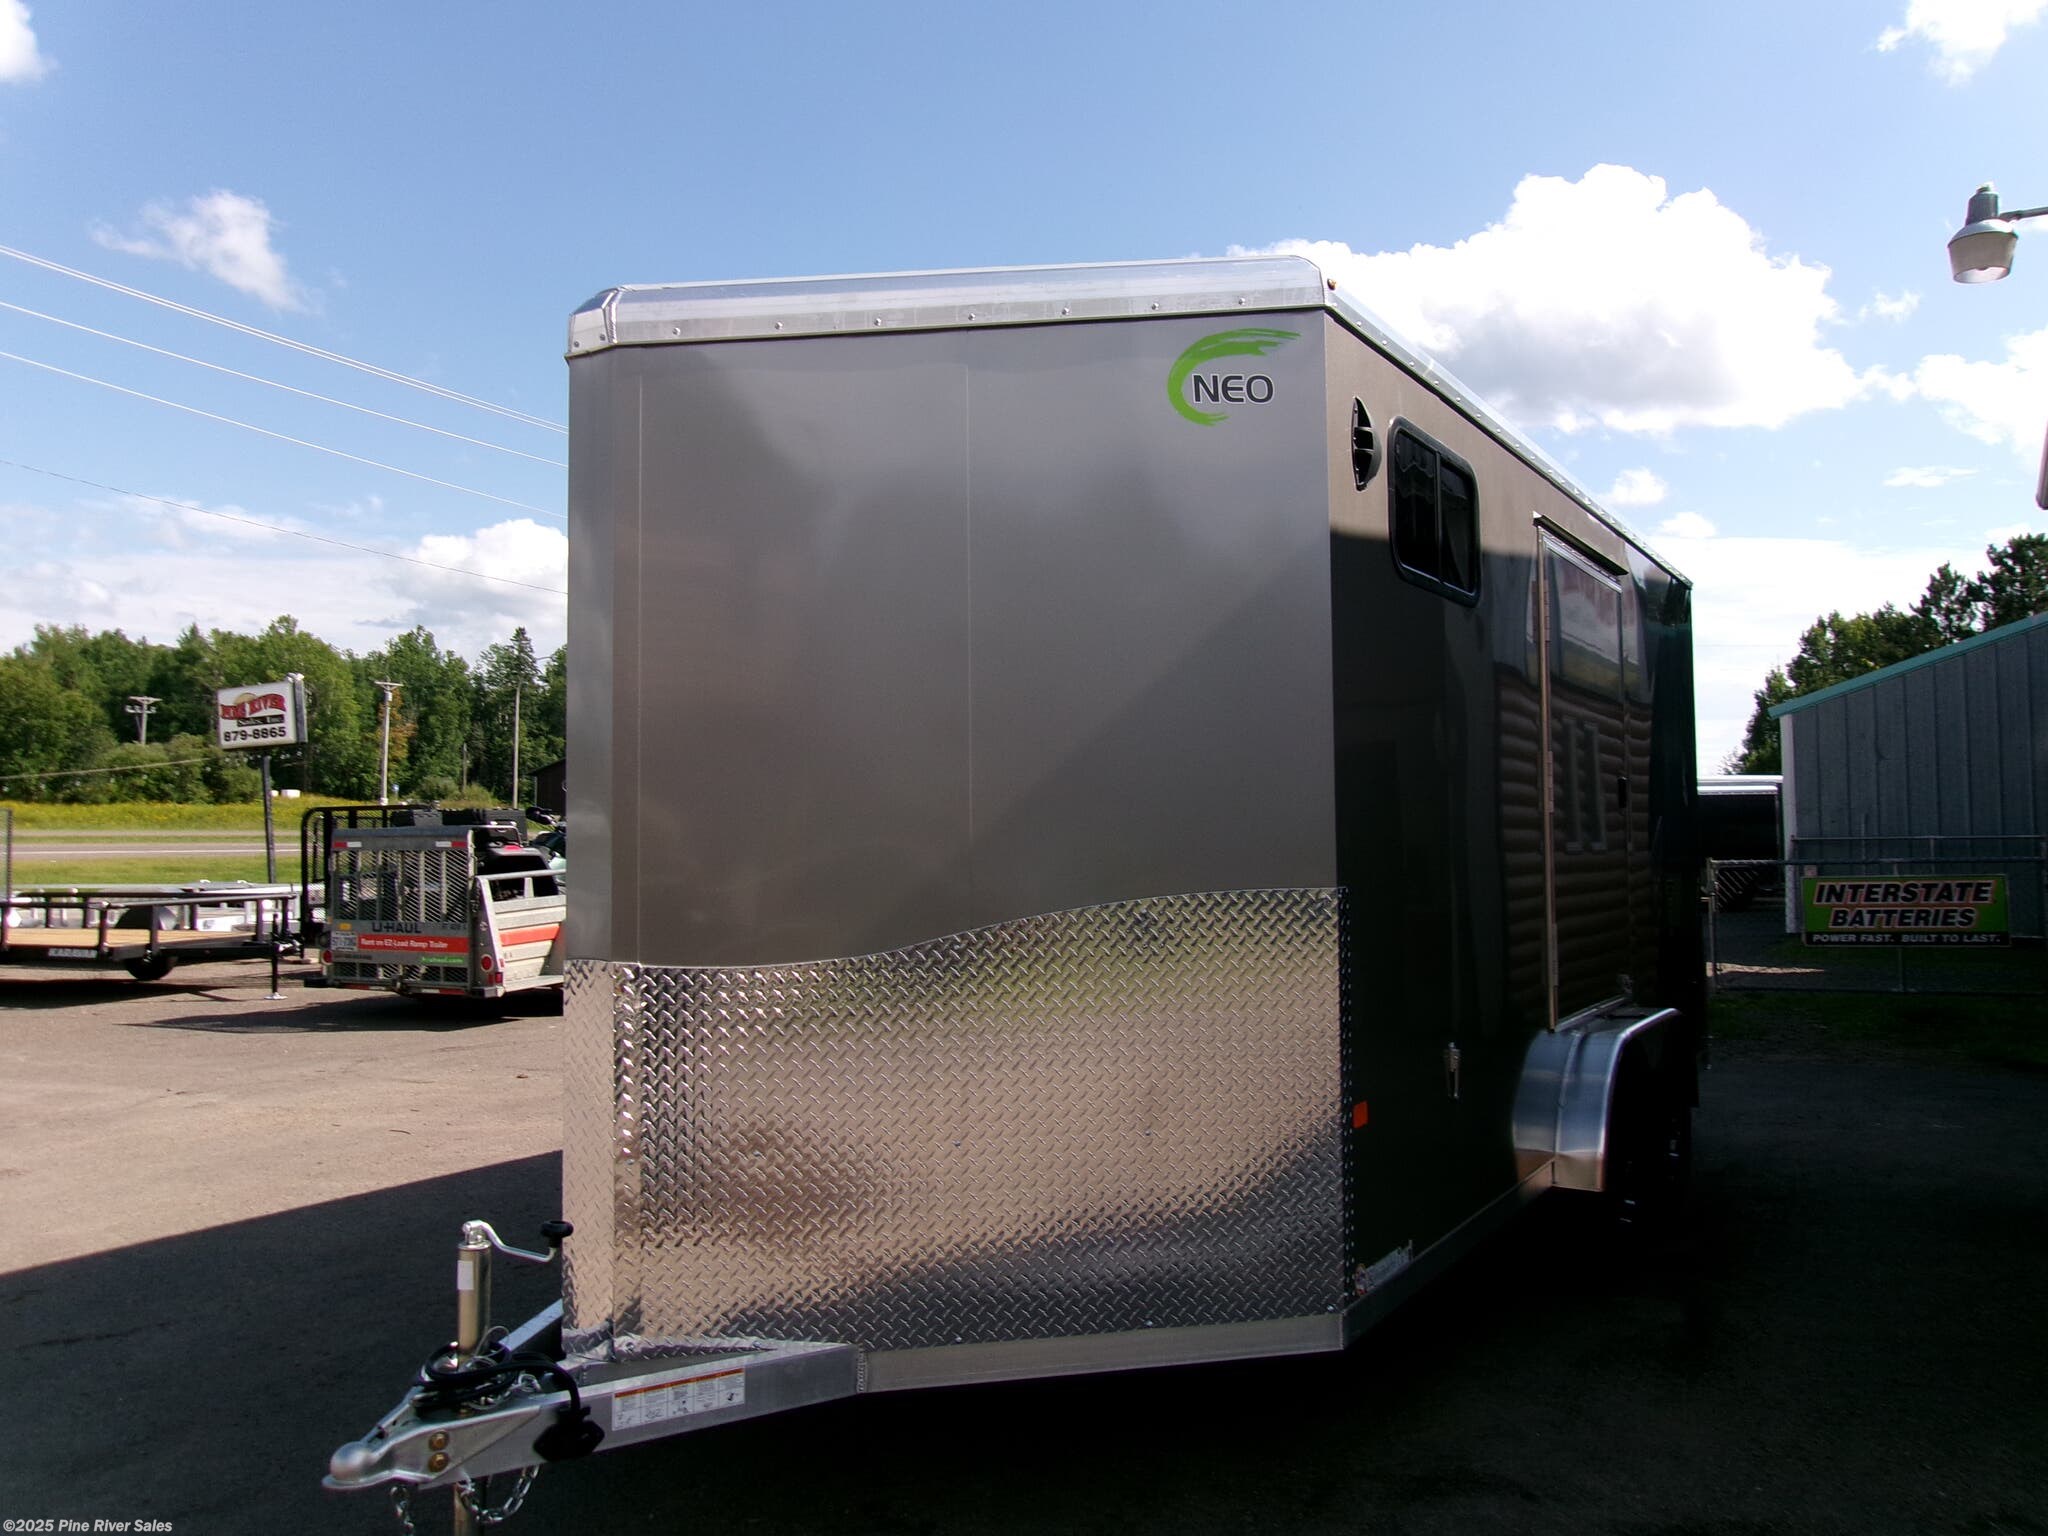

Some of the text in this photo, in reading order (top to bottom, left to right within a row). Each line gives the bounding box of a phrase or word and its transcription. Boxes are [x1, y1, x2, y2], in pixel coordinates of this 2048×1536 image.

[1192, 373, 1275, 404] NEO
[223, 726, 287, 742] 879-8865
[1813, 880, 1996, 904] INTERSTATE
[1828, 906, 1979, 929] BATTERIES
[1812, 933, 2001, 943] POWER FAST. BUILT TO LAST.
